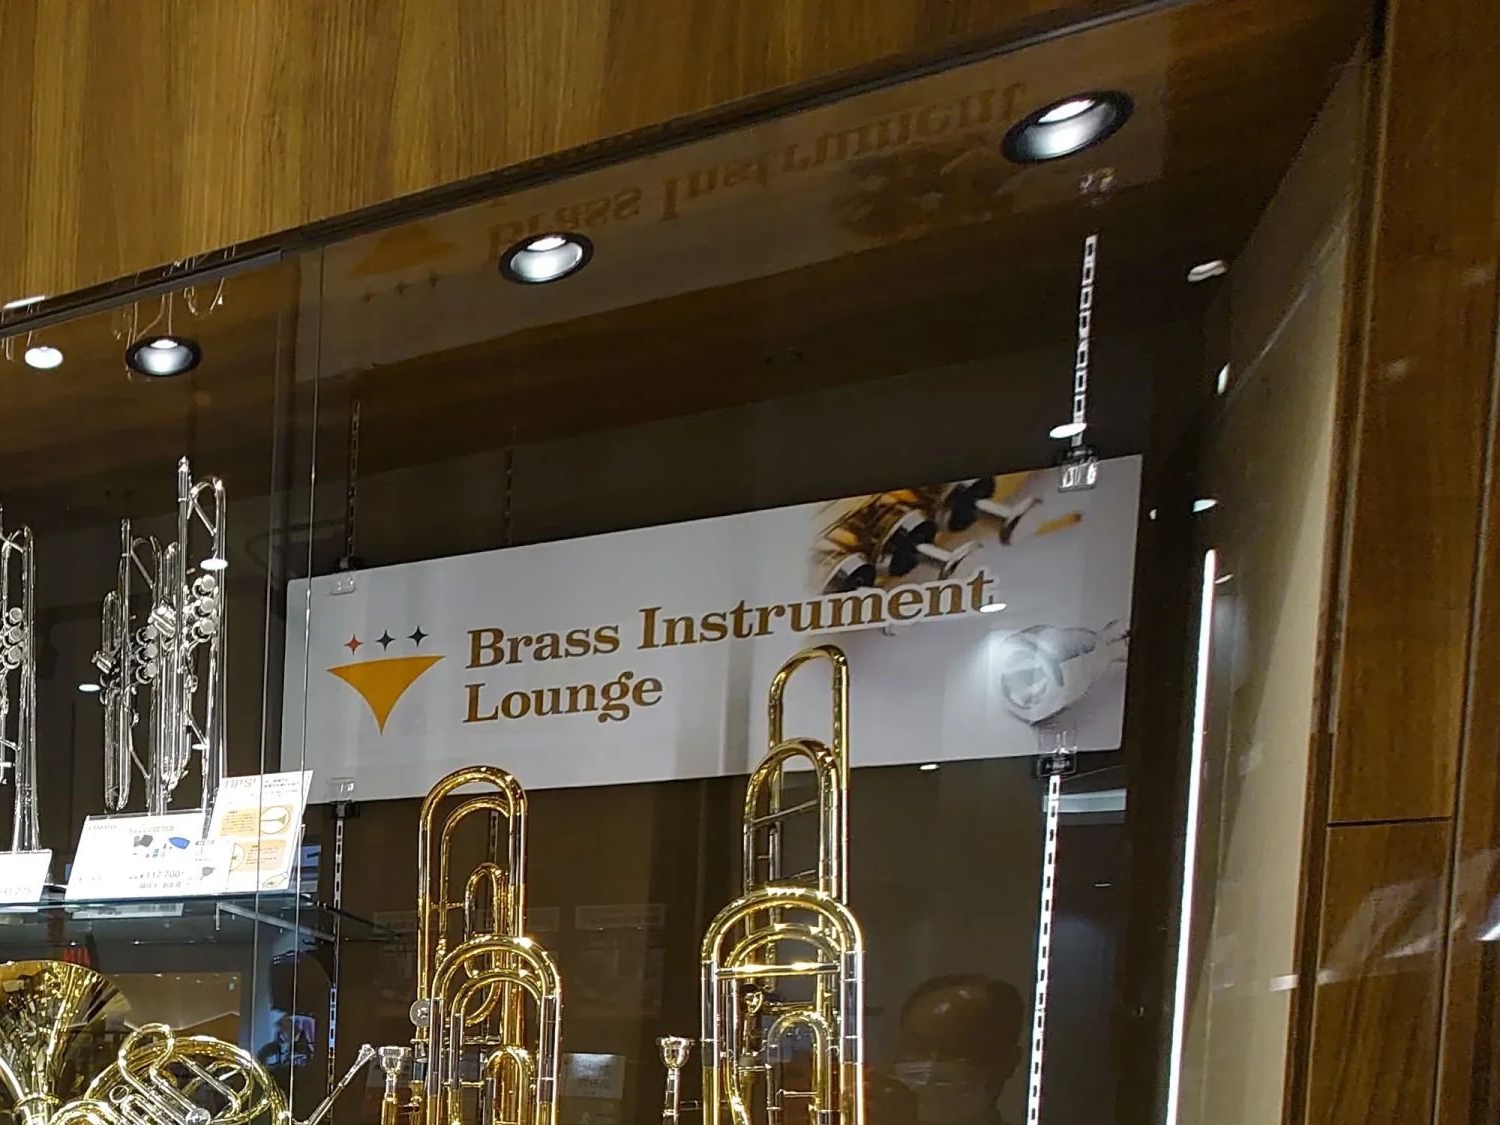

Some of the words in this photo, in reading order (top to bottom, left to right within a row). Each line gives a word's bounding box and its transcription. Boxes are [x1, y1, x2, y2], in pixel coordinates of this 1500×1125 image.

[465, 620, 620, 671] Brass
[637, 568, 997, 652] Instrument
[463, 670, 664, 725] Lounge
